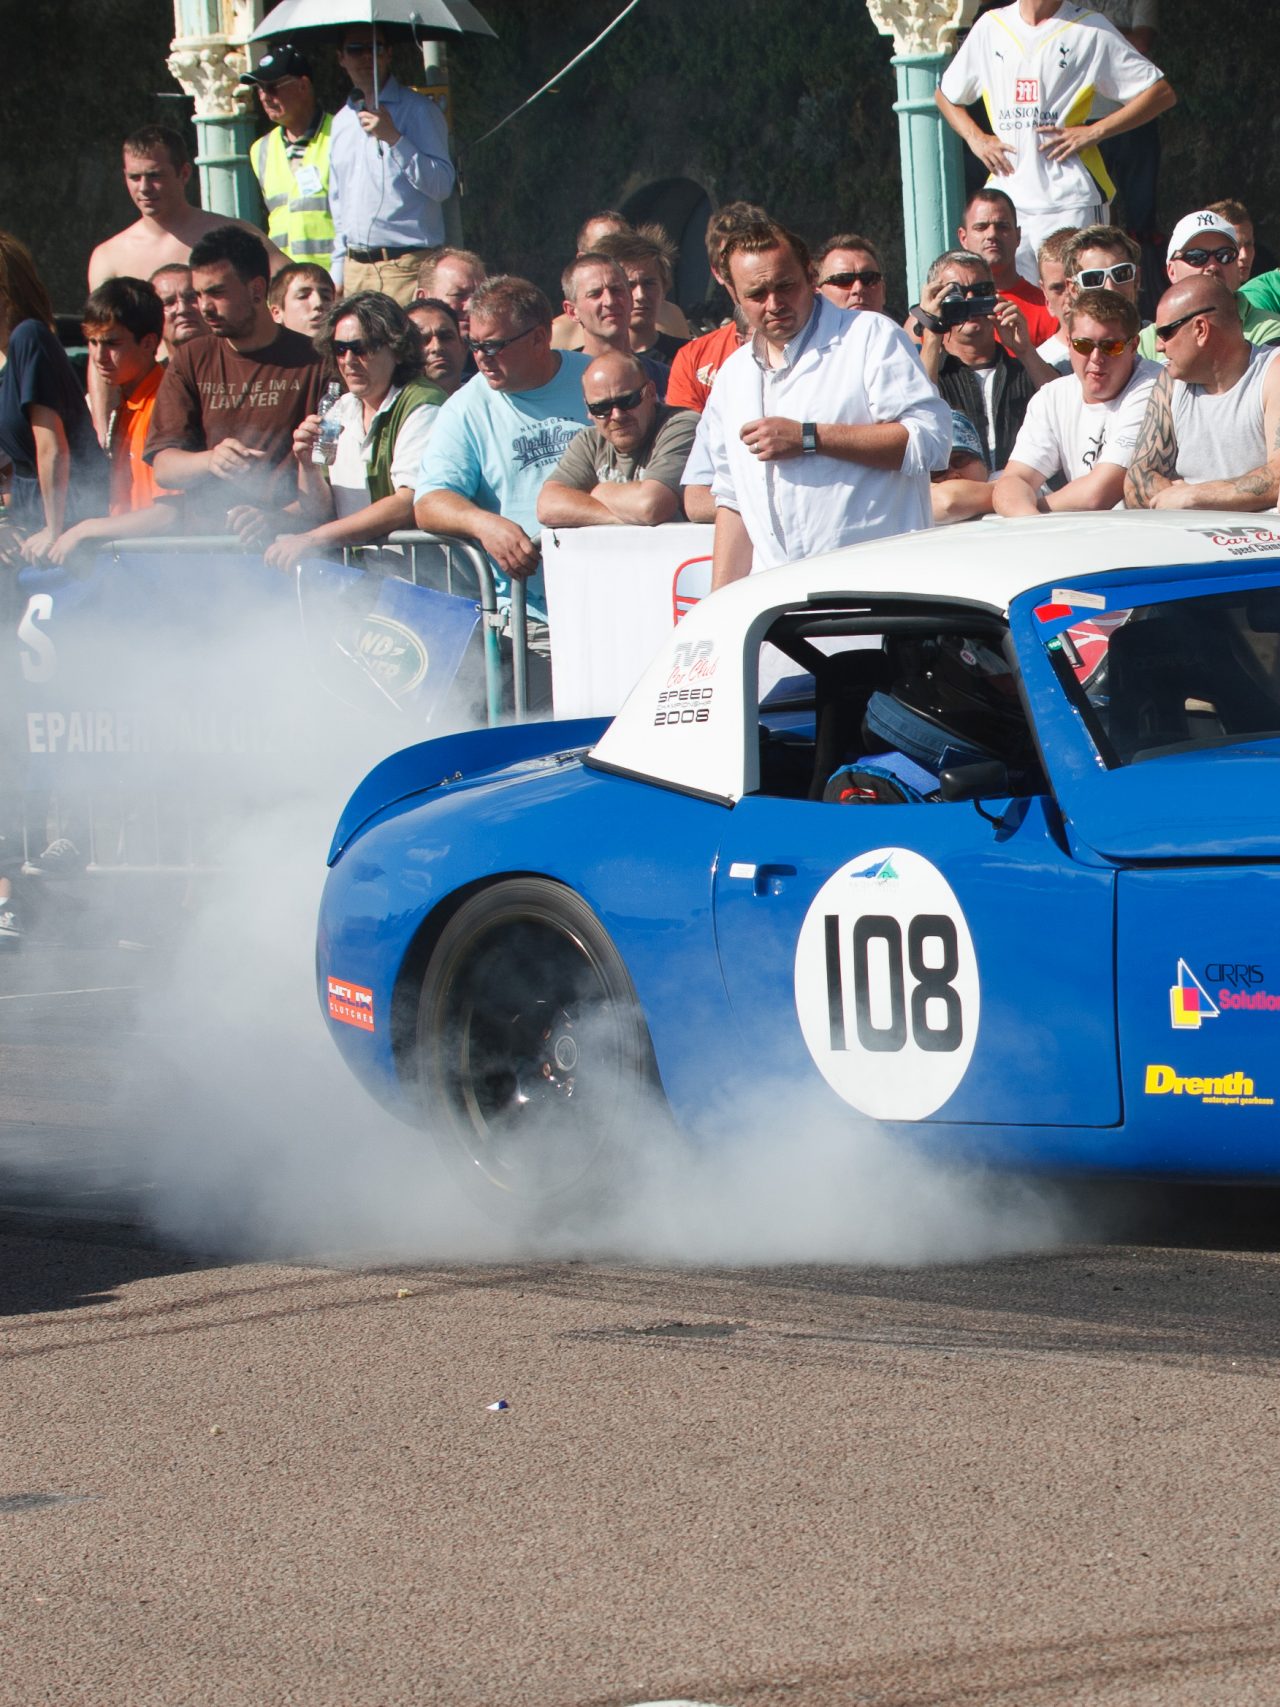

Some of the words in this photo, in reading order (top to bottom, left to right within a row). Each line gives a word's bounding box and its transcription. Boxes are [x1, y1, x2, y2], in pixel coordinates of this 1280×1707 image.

[197, 382, 236, 394] TRUST
[242, 381, 263, 393] ME
[290, 379, 300, 390] A
[210, 391, 280, 409] LAWYER
[1213, 535, 1250, 546] Car
[1228, 544, 1257, 556] Speed
[18, 593, 57, 683] S
[667, 665, 686, 689] Car
[688, 656, 721, 682] Club
[658, 687, 713, 704] SPEED
[654, 708, 710, 726] 2008
[824, 914, 964, 1053] 108
[1205, 963, 1265, 988] CIRRIS
[329, 983, 372, 1011] HELIX
[330, 1002, 374, 1024] CLUTCHES
[1145, 1064, 1254, 1096] Drenth
